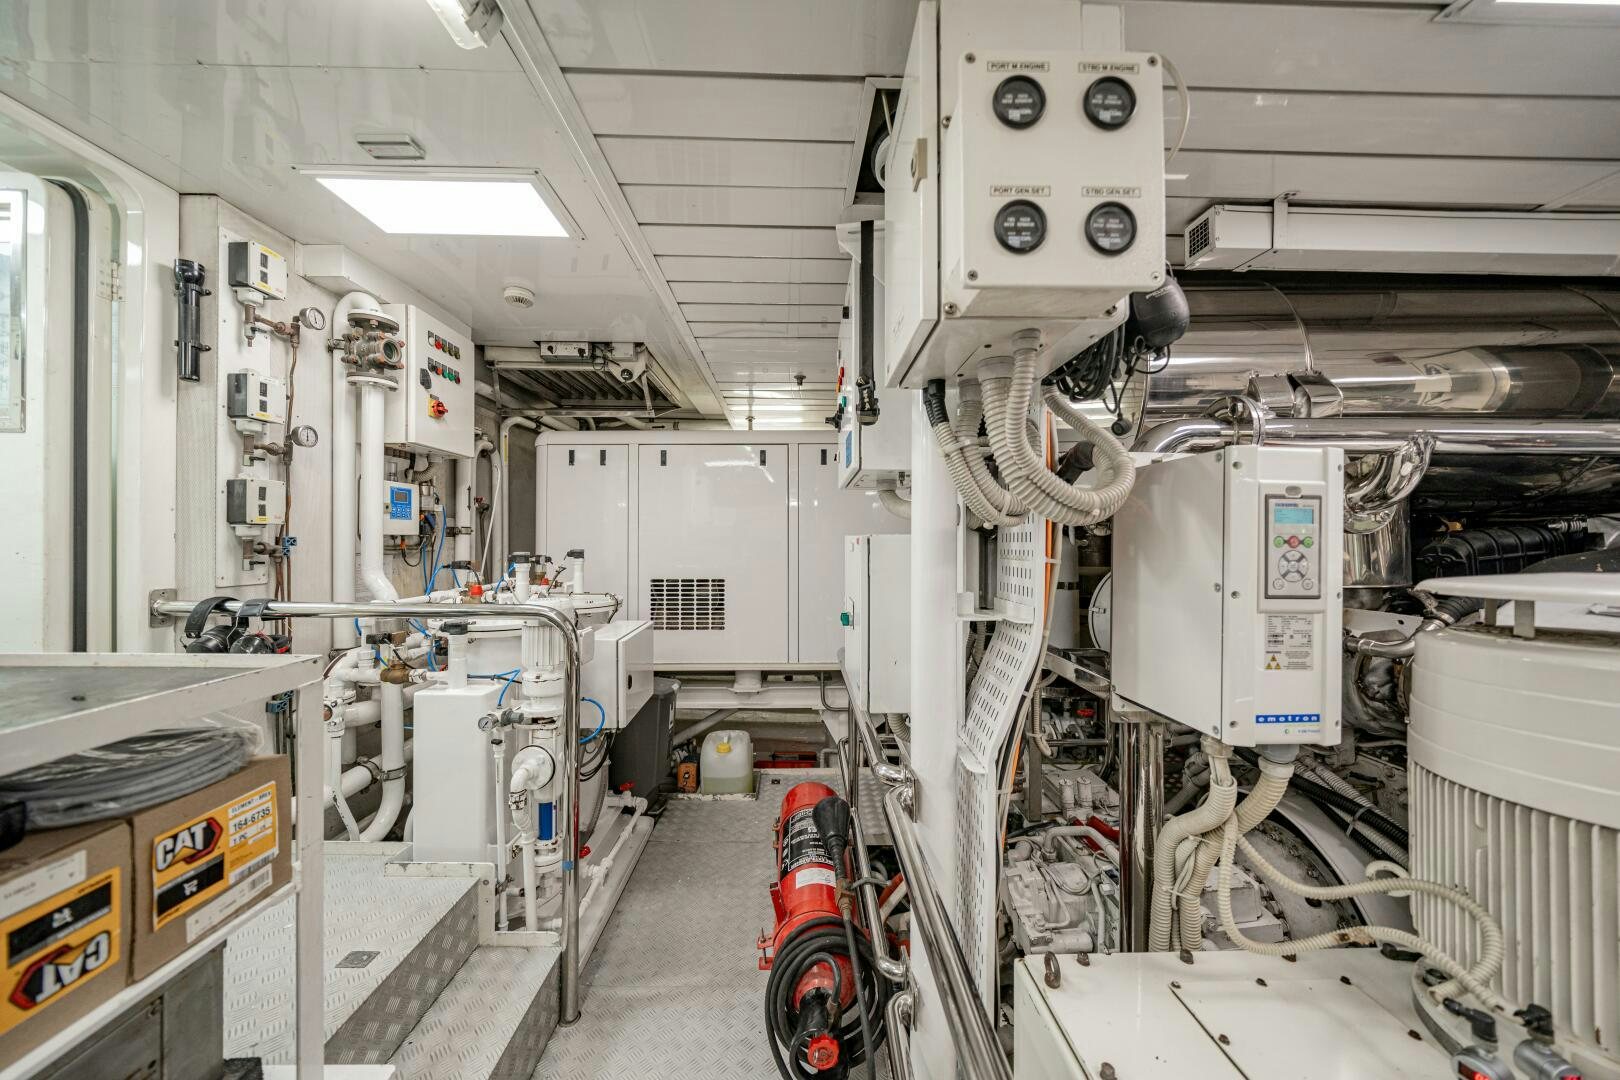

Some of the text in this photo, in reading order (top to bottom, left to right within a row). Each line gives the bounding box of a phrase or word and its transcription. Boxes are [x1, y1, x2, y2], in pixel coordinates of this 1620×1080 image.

[1020, 63, 1046, 71] ENGINE
[232, 806, 271, 832] 164-6735
[155, 821, 208, 872] CAT
[35, 932, 111, 1003] CAT
